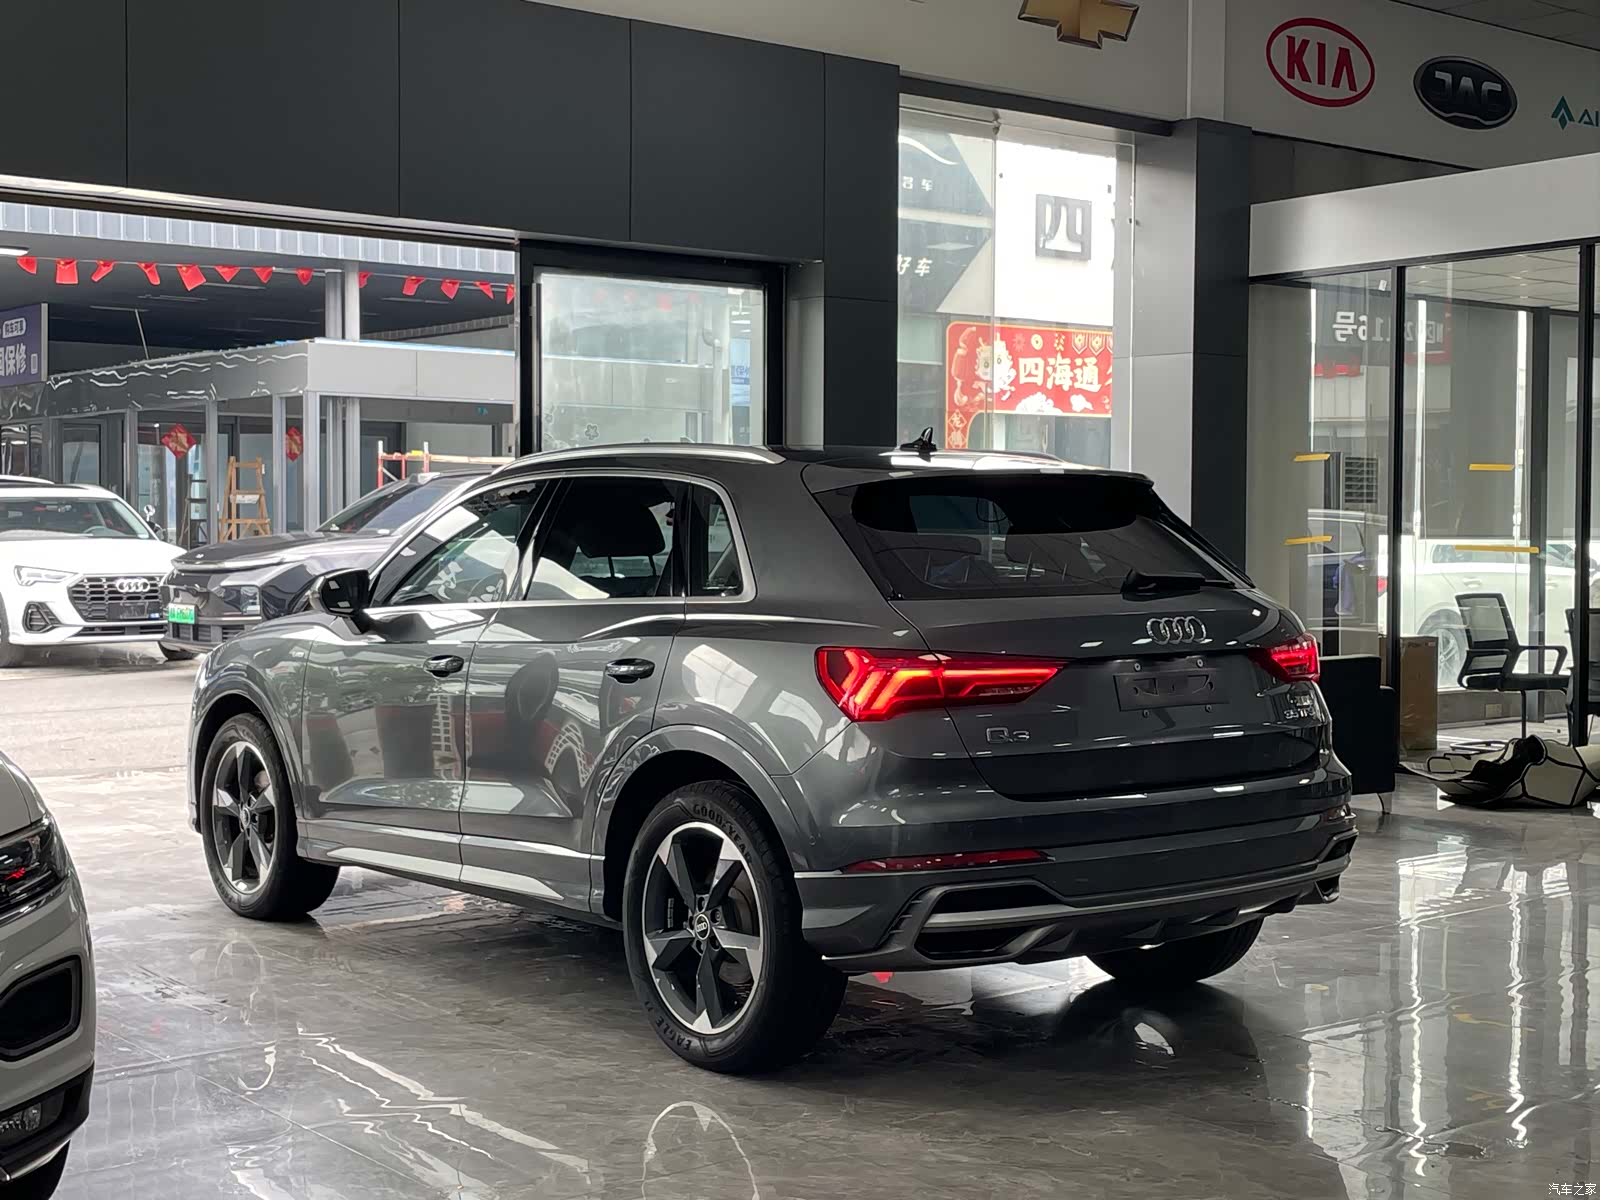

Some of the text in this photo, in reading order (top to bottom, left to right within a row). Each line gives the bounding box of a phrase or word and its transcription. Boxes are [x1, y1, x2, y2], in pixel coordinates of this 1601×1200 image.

[1286, 35, 1358, 92] KIA
[986, 727, 1030, 744] Q3
[655, 1015, 692, 1051] EAGLE
